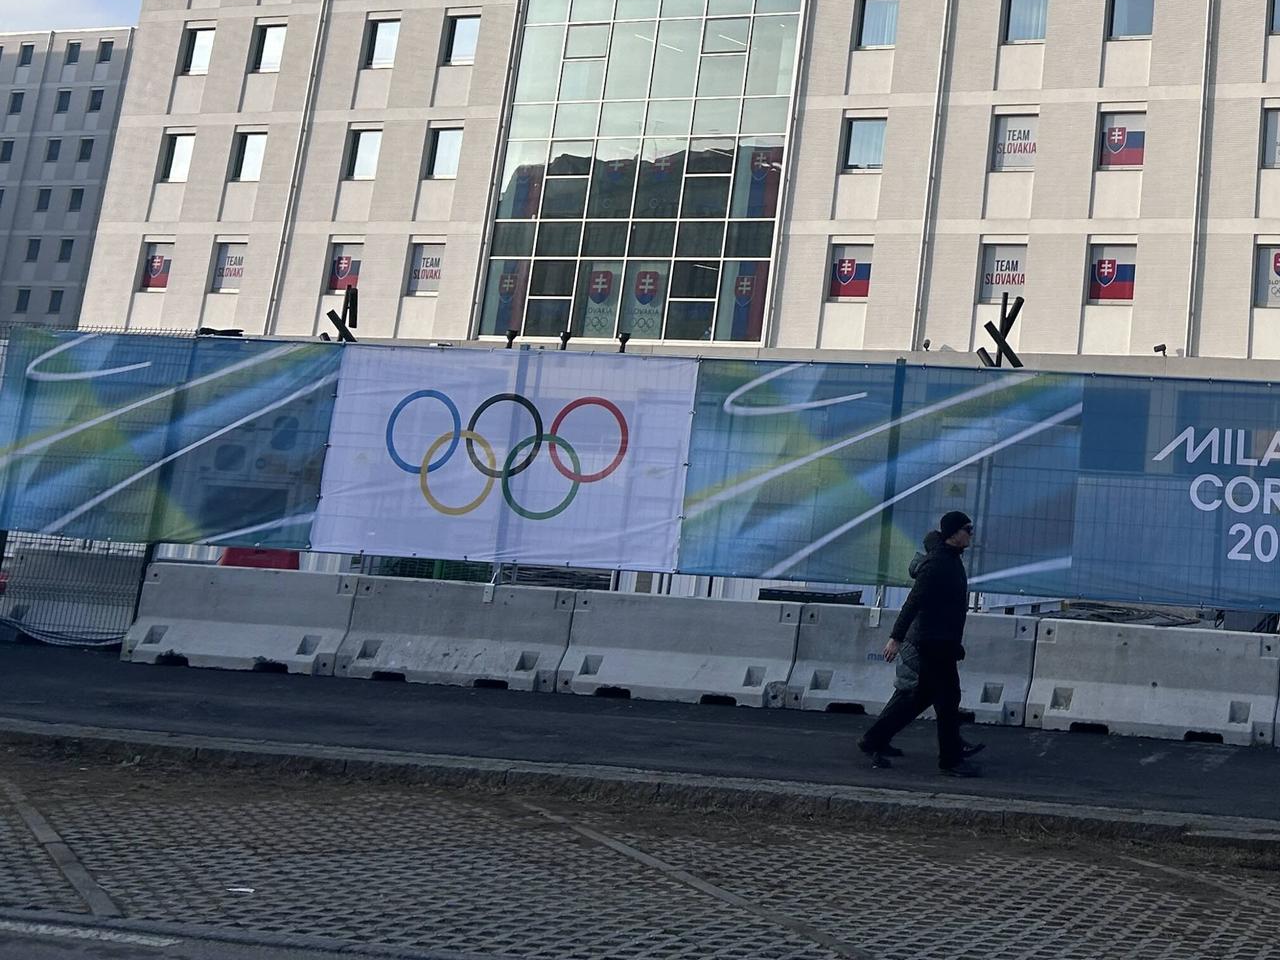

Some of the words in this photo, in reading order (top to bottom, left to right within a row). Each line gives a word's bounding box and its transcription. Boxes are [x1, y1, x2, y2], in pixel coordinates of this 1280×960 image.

[1007, 129, 1030, 141] TEAM
[996, 142, 1037, 154] SLOVAKIA
[227, 256, 243, 266] TEAM
[422, 257, 440, 268] TEAM
[995, 260, 1019, 271] TEAM
[217, 267, 243, 278] SLOVAKI
[413, 269, 441, 280] SLOVAKI
[984, 273, 1025, 285] SLOVAKIA
